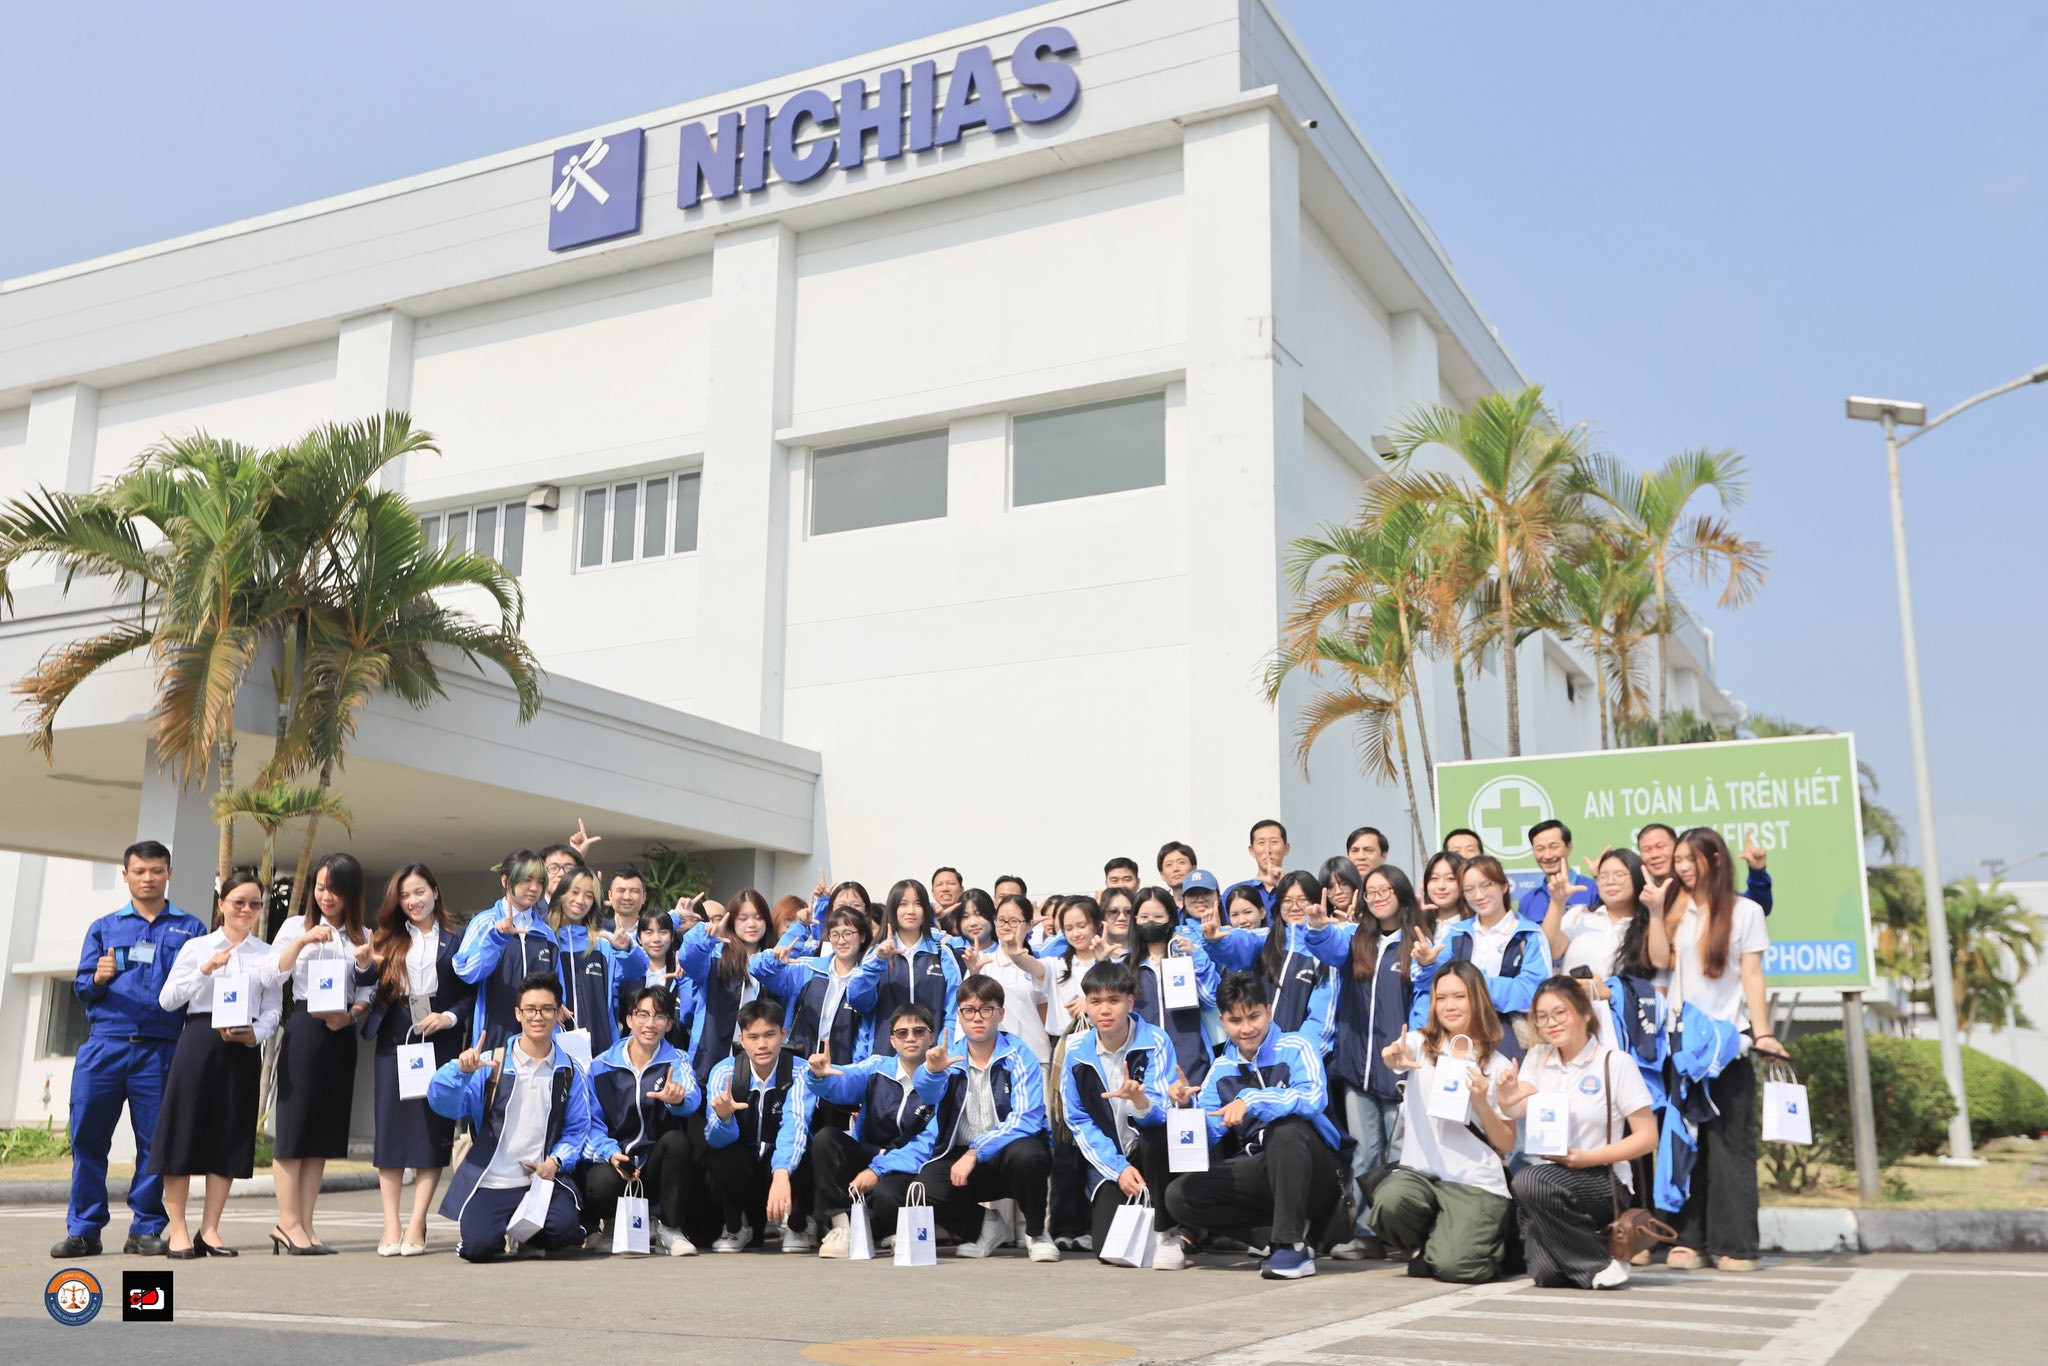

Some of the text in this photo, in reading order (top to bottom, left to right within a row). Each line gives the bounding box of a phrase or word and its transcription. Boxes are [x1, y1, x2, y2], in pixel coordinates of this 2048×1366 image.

[677, 26, 1080, 210] NICHIAS
[1584, 766, 1841, 819] AN TOÀN LÀ TRÊN HẾT
[1724, 820, 1790, 851] FIRST
